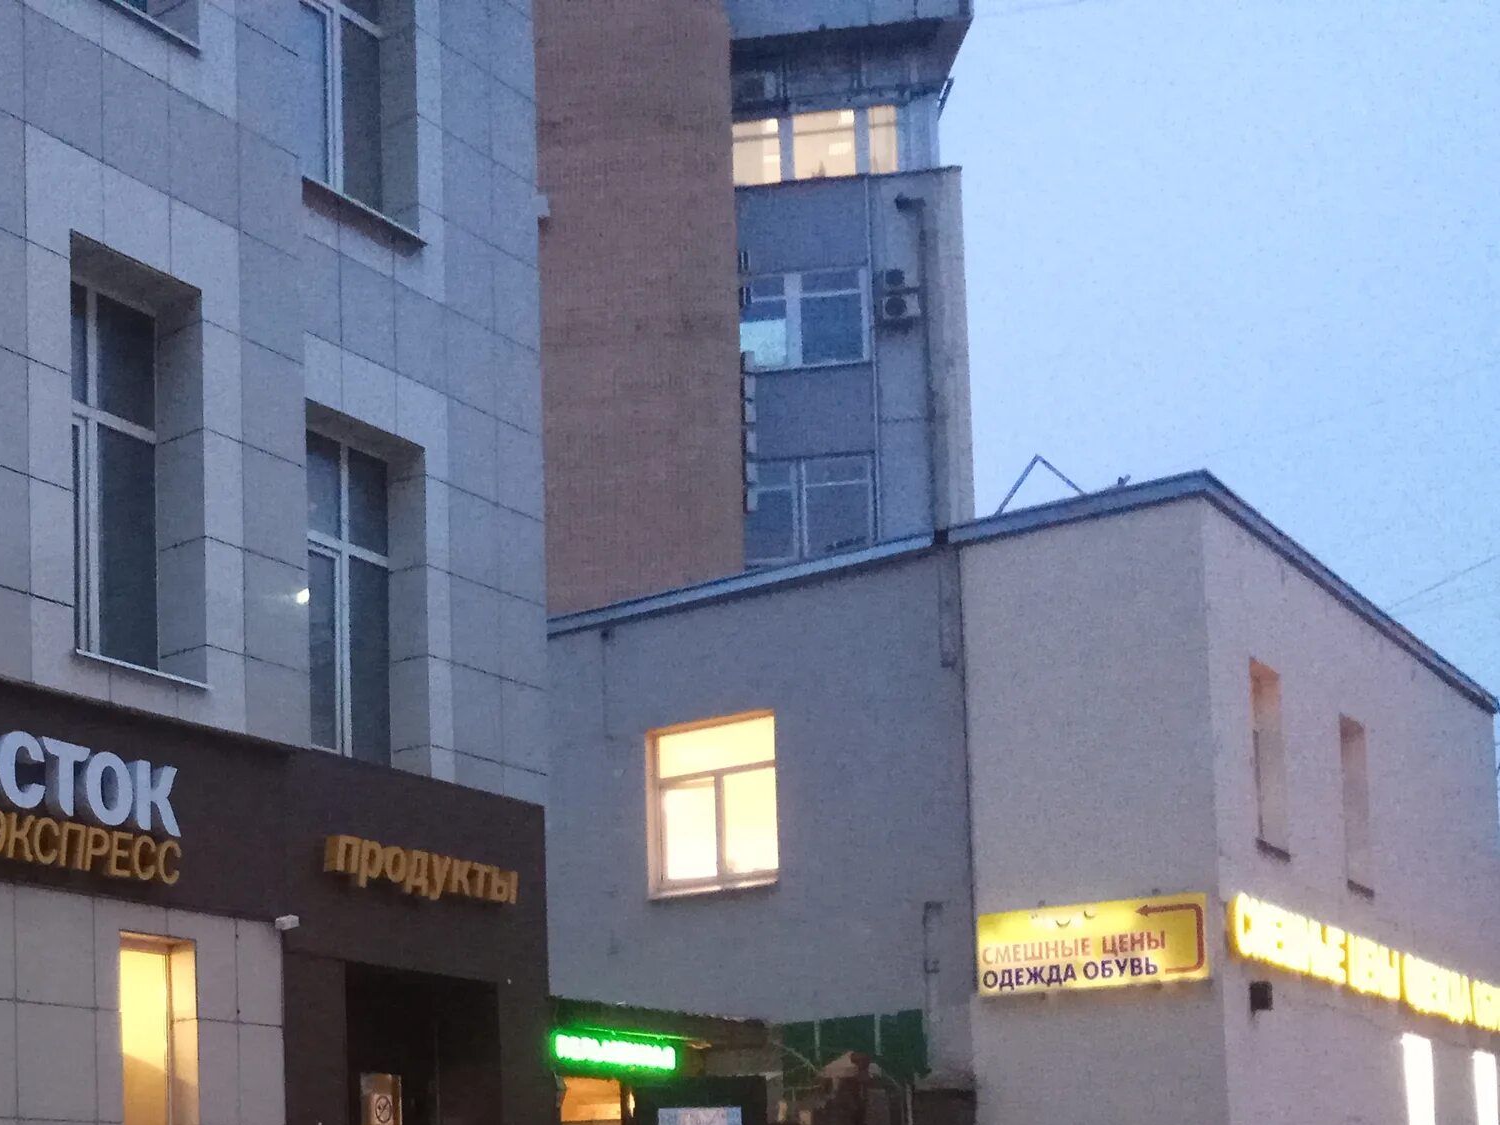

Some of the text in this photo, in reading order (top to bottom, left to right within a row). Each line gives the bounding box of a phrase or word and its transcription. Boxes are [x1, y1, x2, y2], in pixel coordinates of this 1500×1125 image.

[981, 930, 1166, 966] СМЕШНЫЕ ЦЕНЫ
[982, 956, 1159, 992] ОДЕЖДА ОБУВЬ
